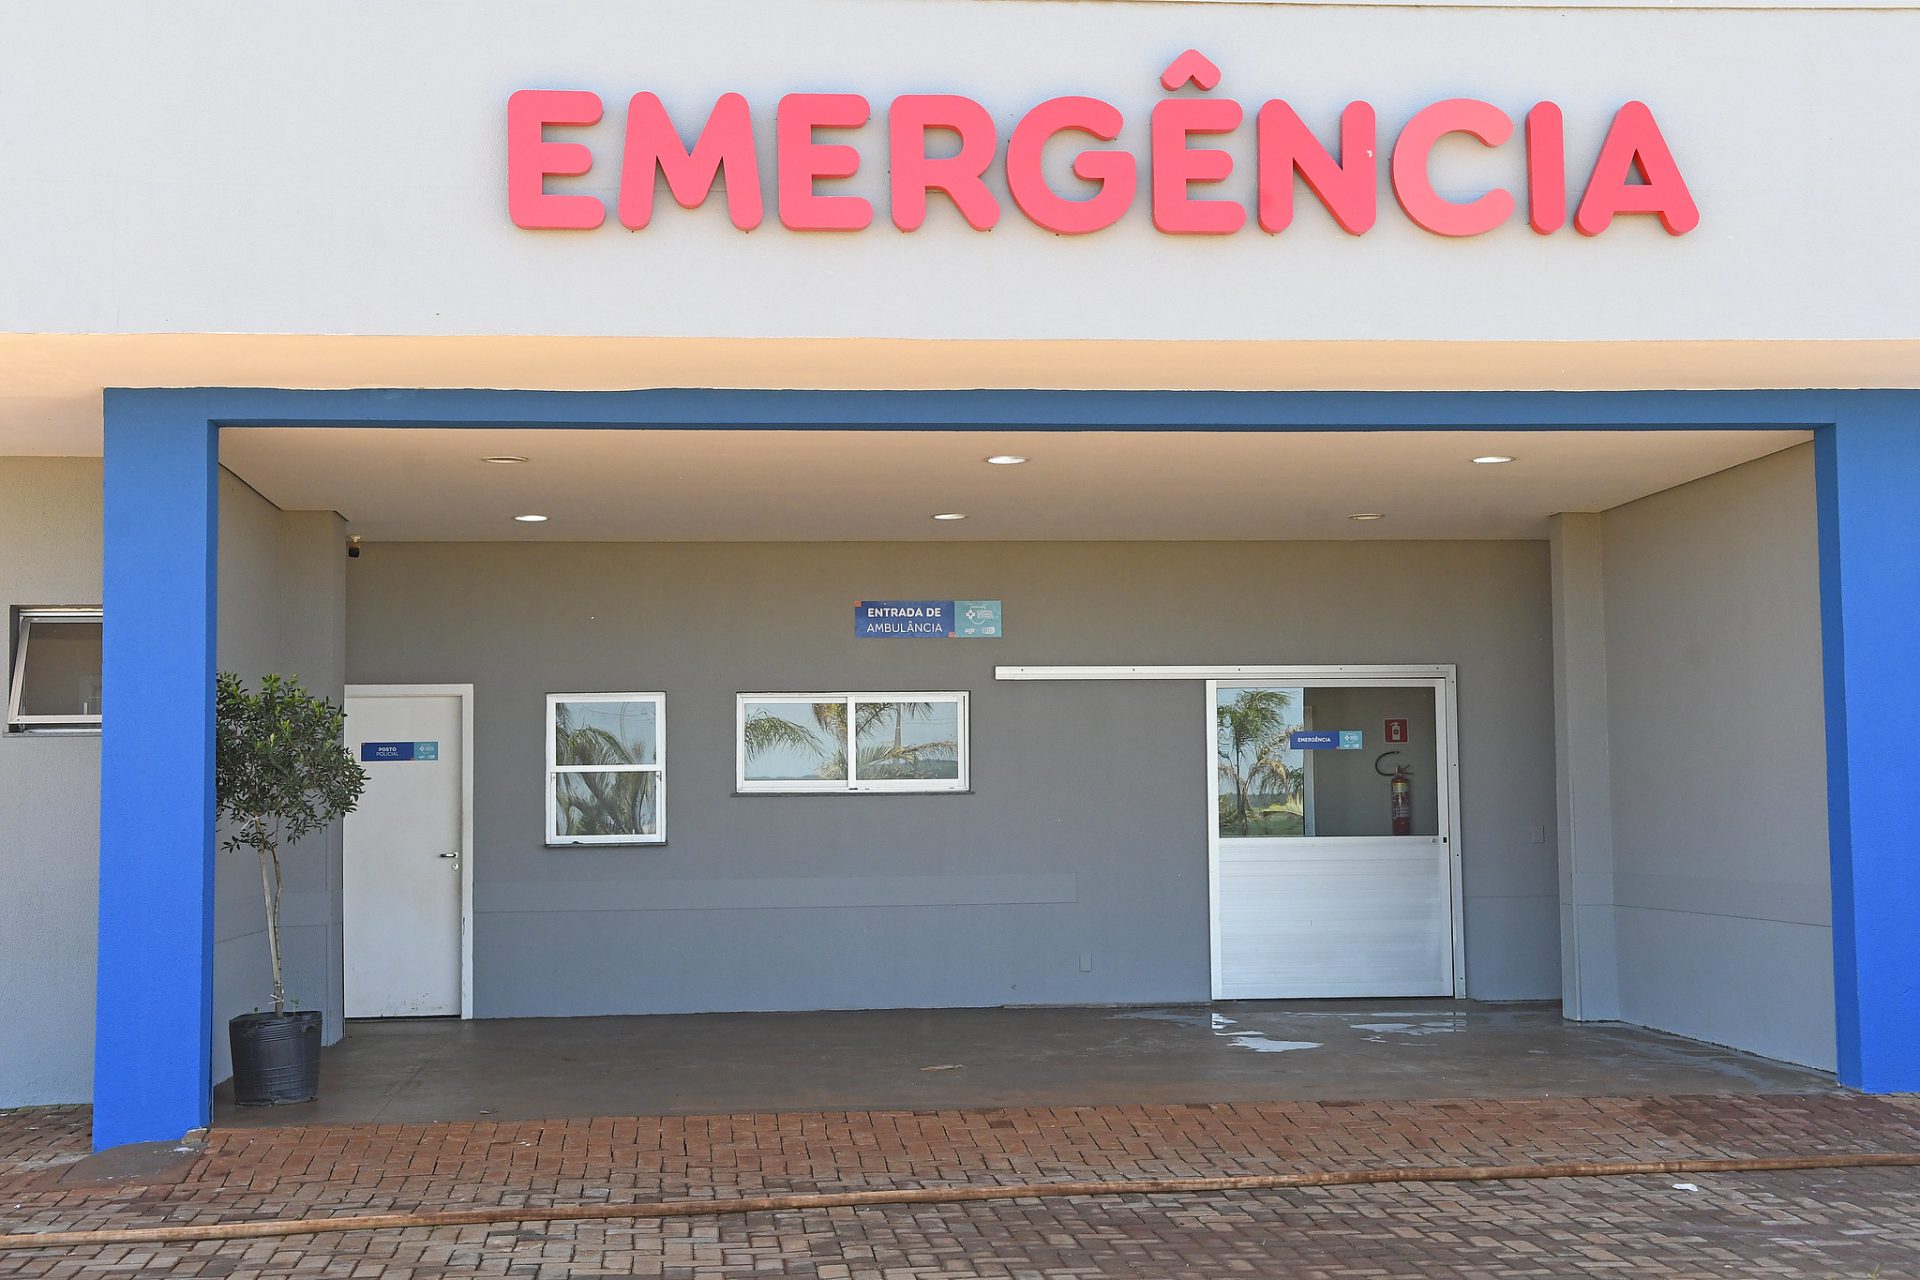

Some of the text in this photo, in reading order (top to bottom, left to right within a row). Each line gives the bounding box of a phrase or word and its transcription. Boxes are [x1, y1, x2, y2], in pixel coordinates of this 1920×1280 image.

[507, 49, 1701, 237] EMERGÊNCIA
[867, 607, 942, 618] ENTRADA DE
[866, 620, 943, 633] AMBULÂNCIA
[1297, 735, 1331, 743] EMERGÊNCIA
